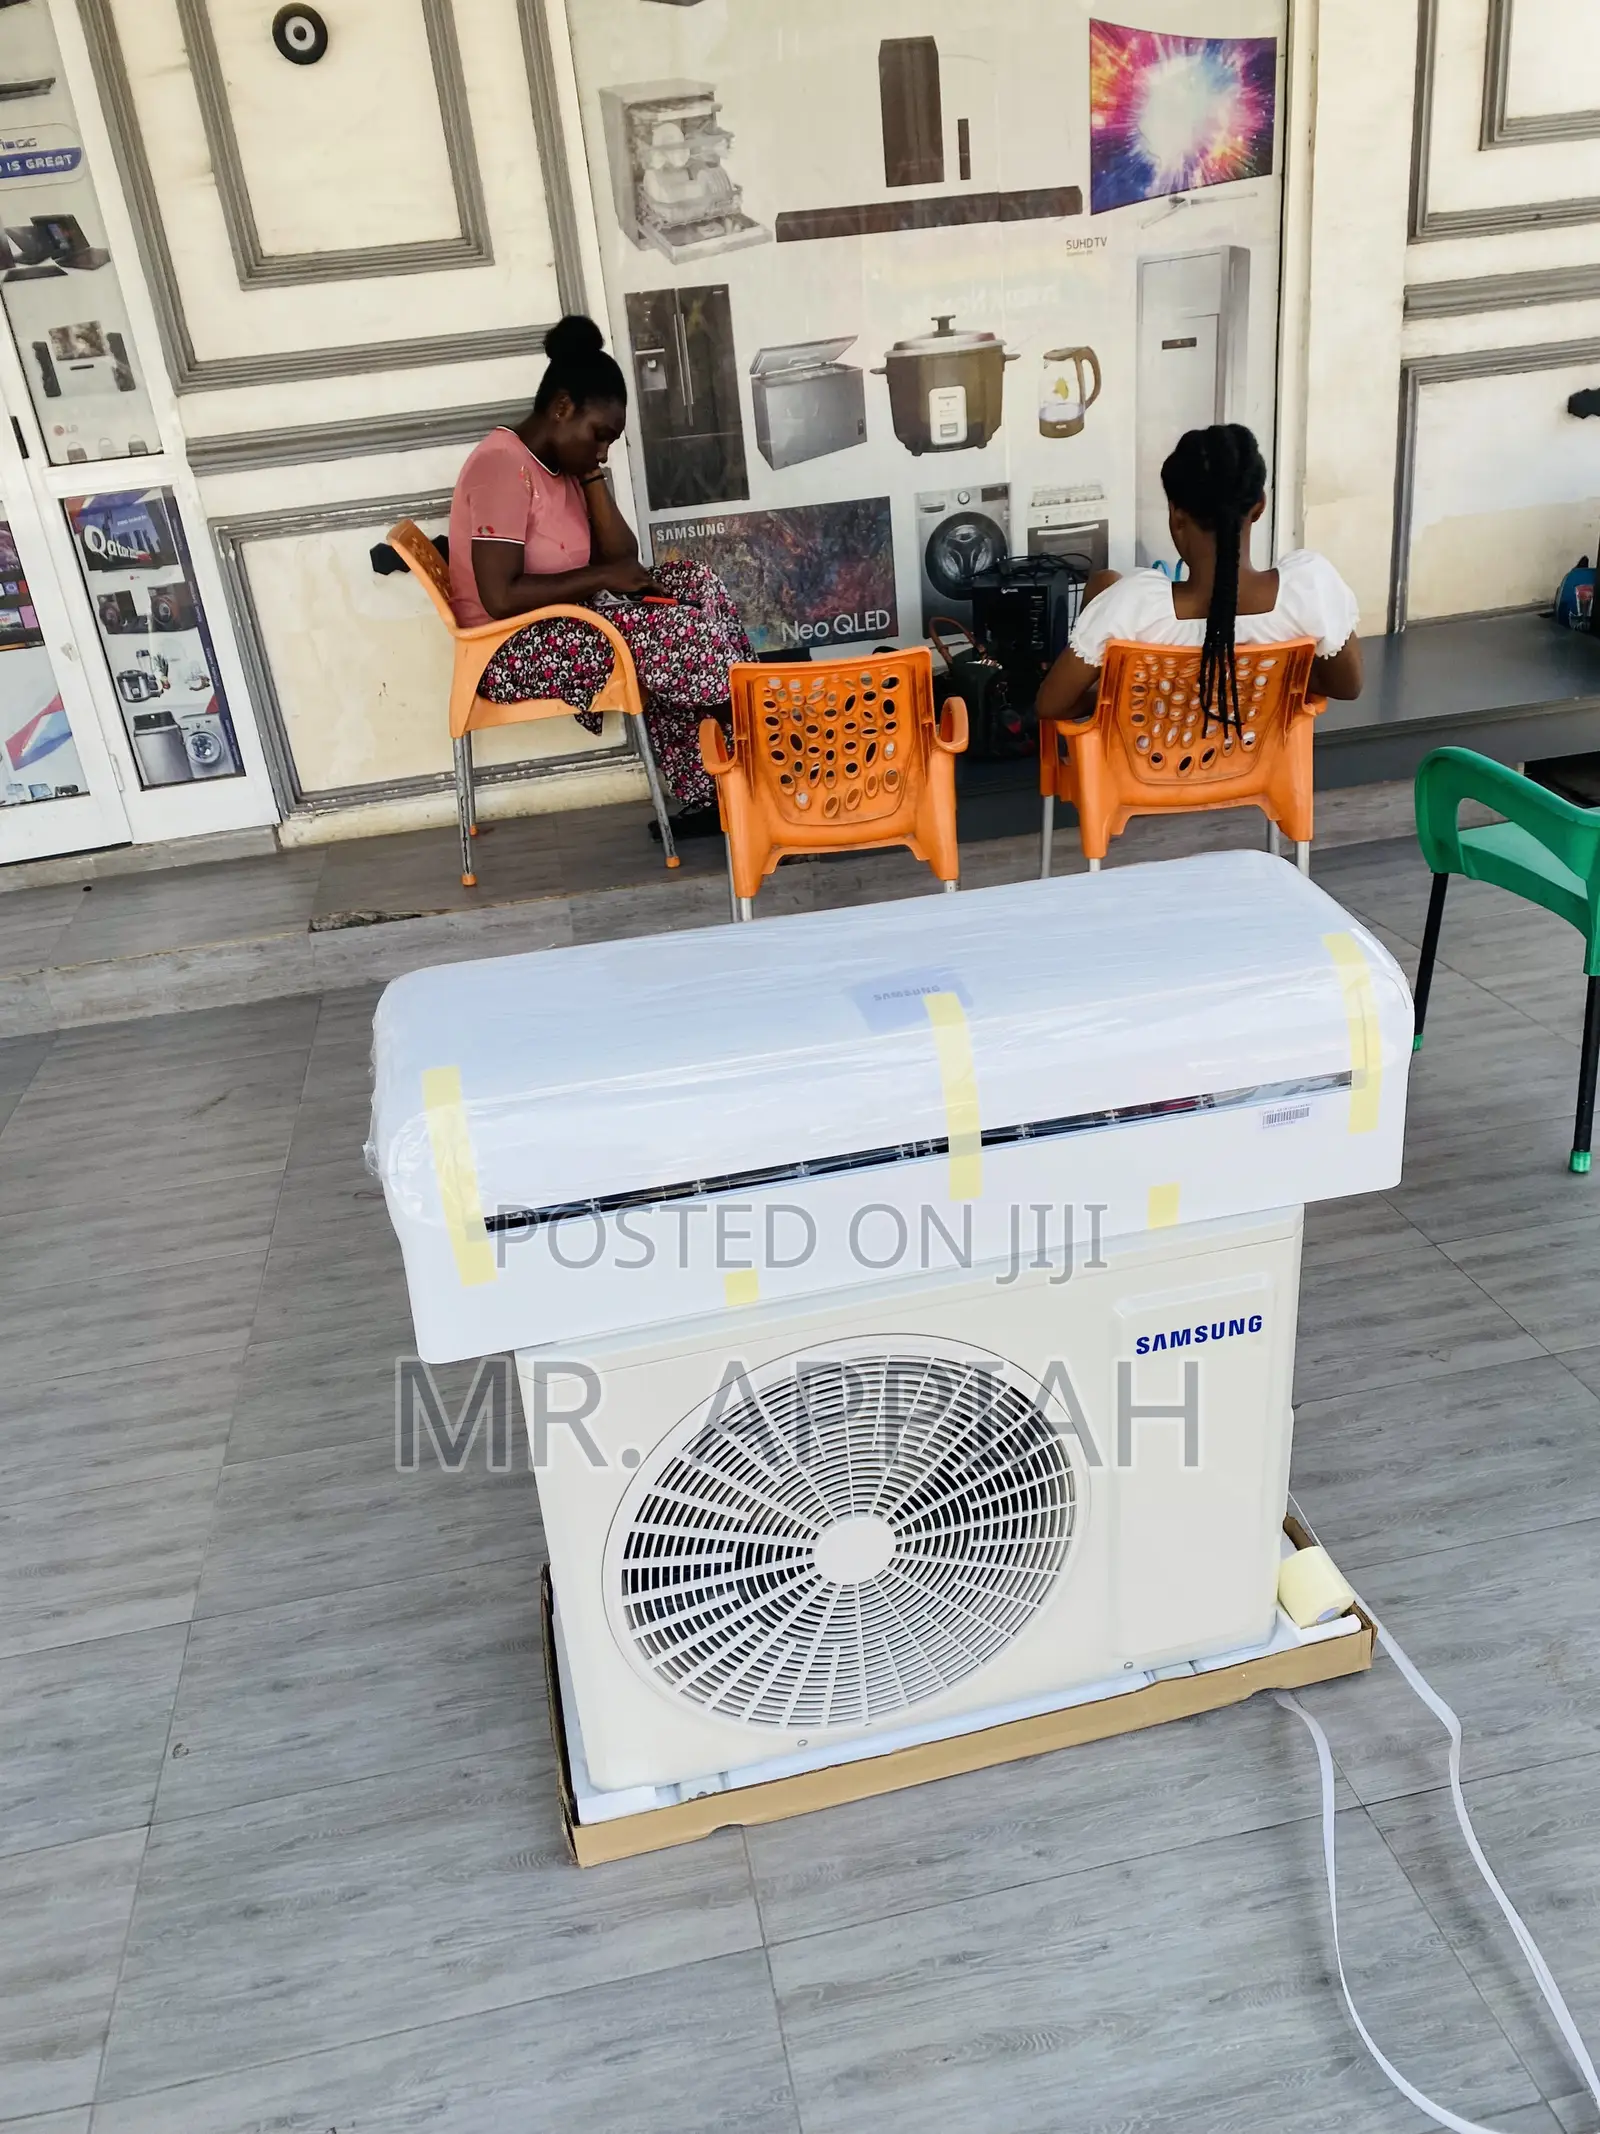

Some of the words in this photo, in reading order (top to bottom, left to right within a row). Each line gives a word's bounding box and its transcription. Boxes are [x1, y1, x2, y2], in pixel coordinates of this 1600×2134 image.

[7, 160, 21, 172] IS
[25, 154, 72, 170] GREAT
[656, 522, 726, 542] SAMSUNG
[780, 620, 829, 643] Neo
[833, 609, 891, 636] QLED
[872, 984, 941, 1002] SAMSUNG
[1135, 1314, 1263, 1355] SAMSUNG
